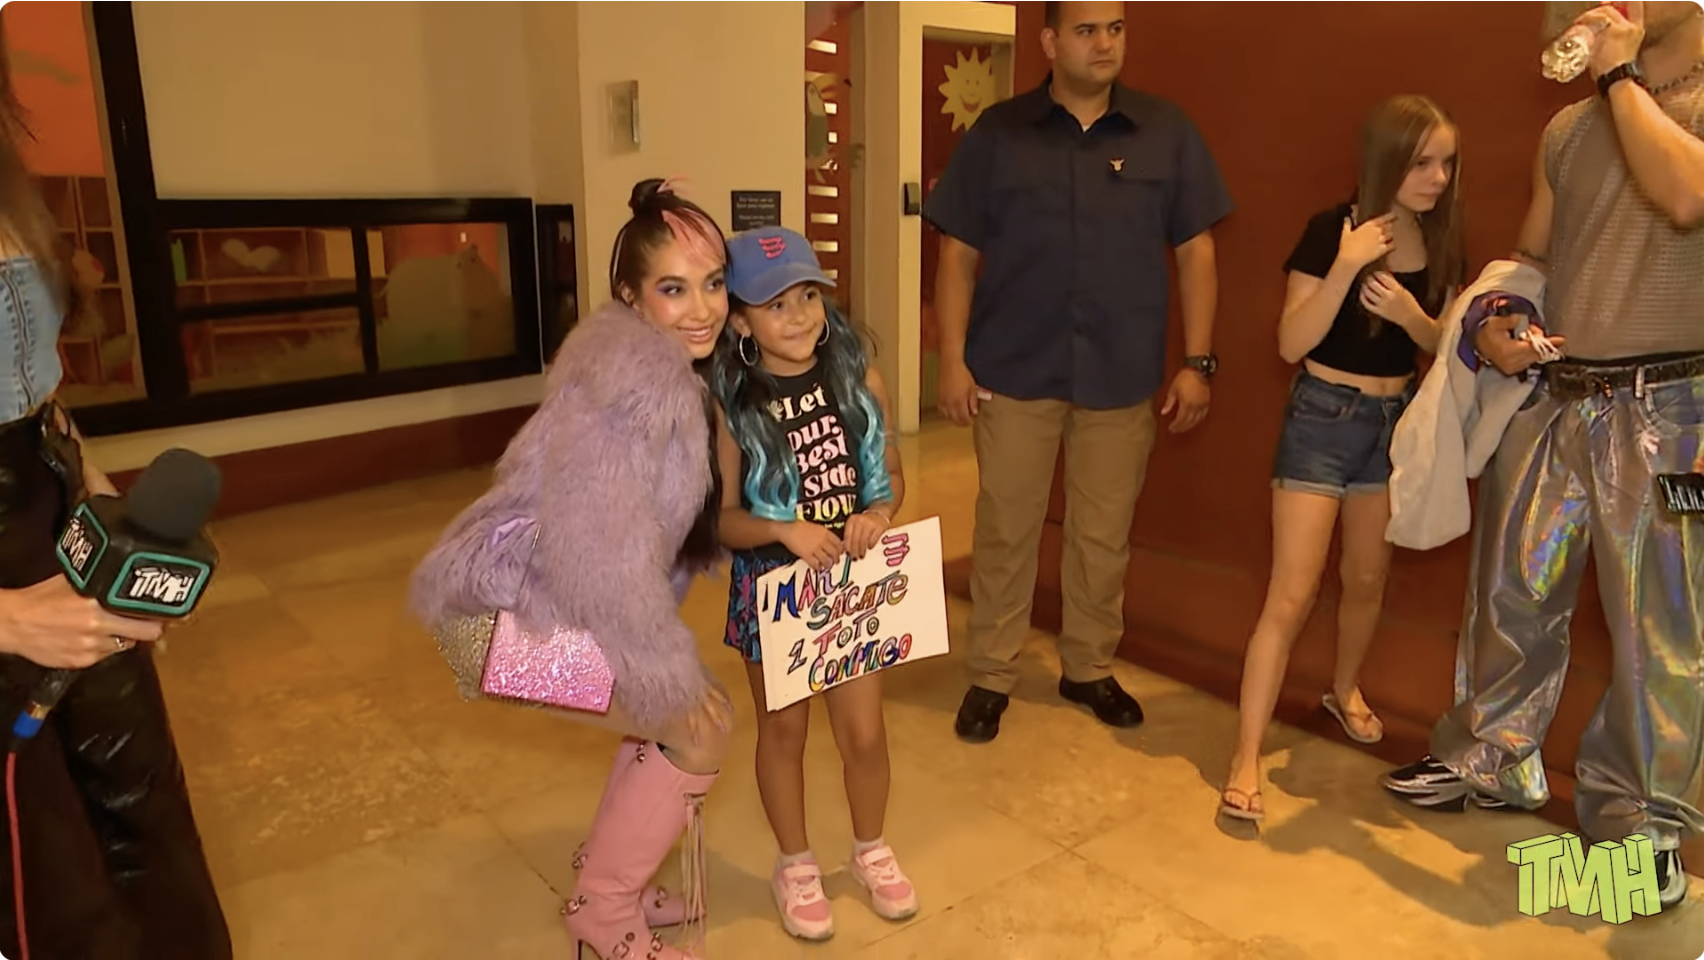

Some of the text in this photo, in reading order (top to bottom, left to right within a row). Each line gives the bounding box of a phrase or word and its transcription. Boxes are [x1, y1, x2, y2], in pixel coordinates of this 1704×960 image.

[787, 606, 880, 675] 1 FOTO
[808, 633, 913, 692] CONMIGO
